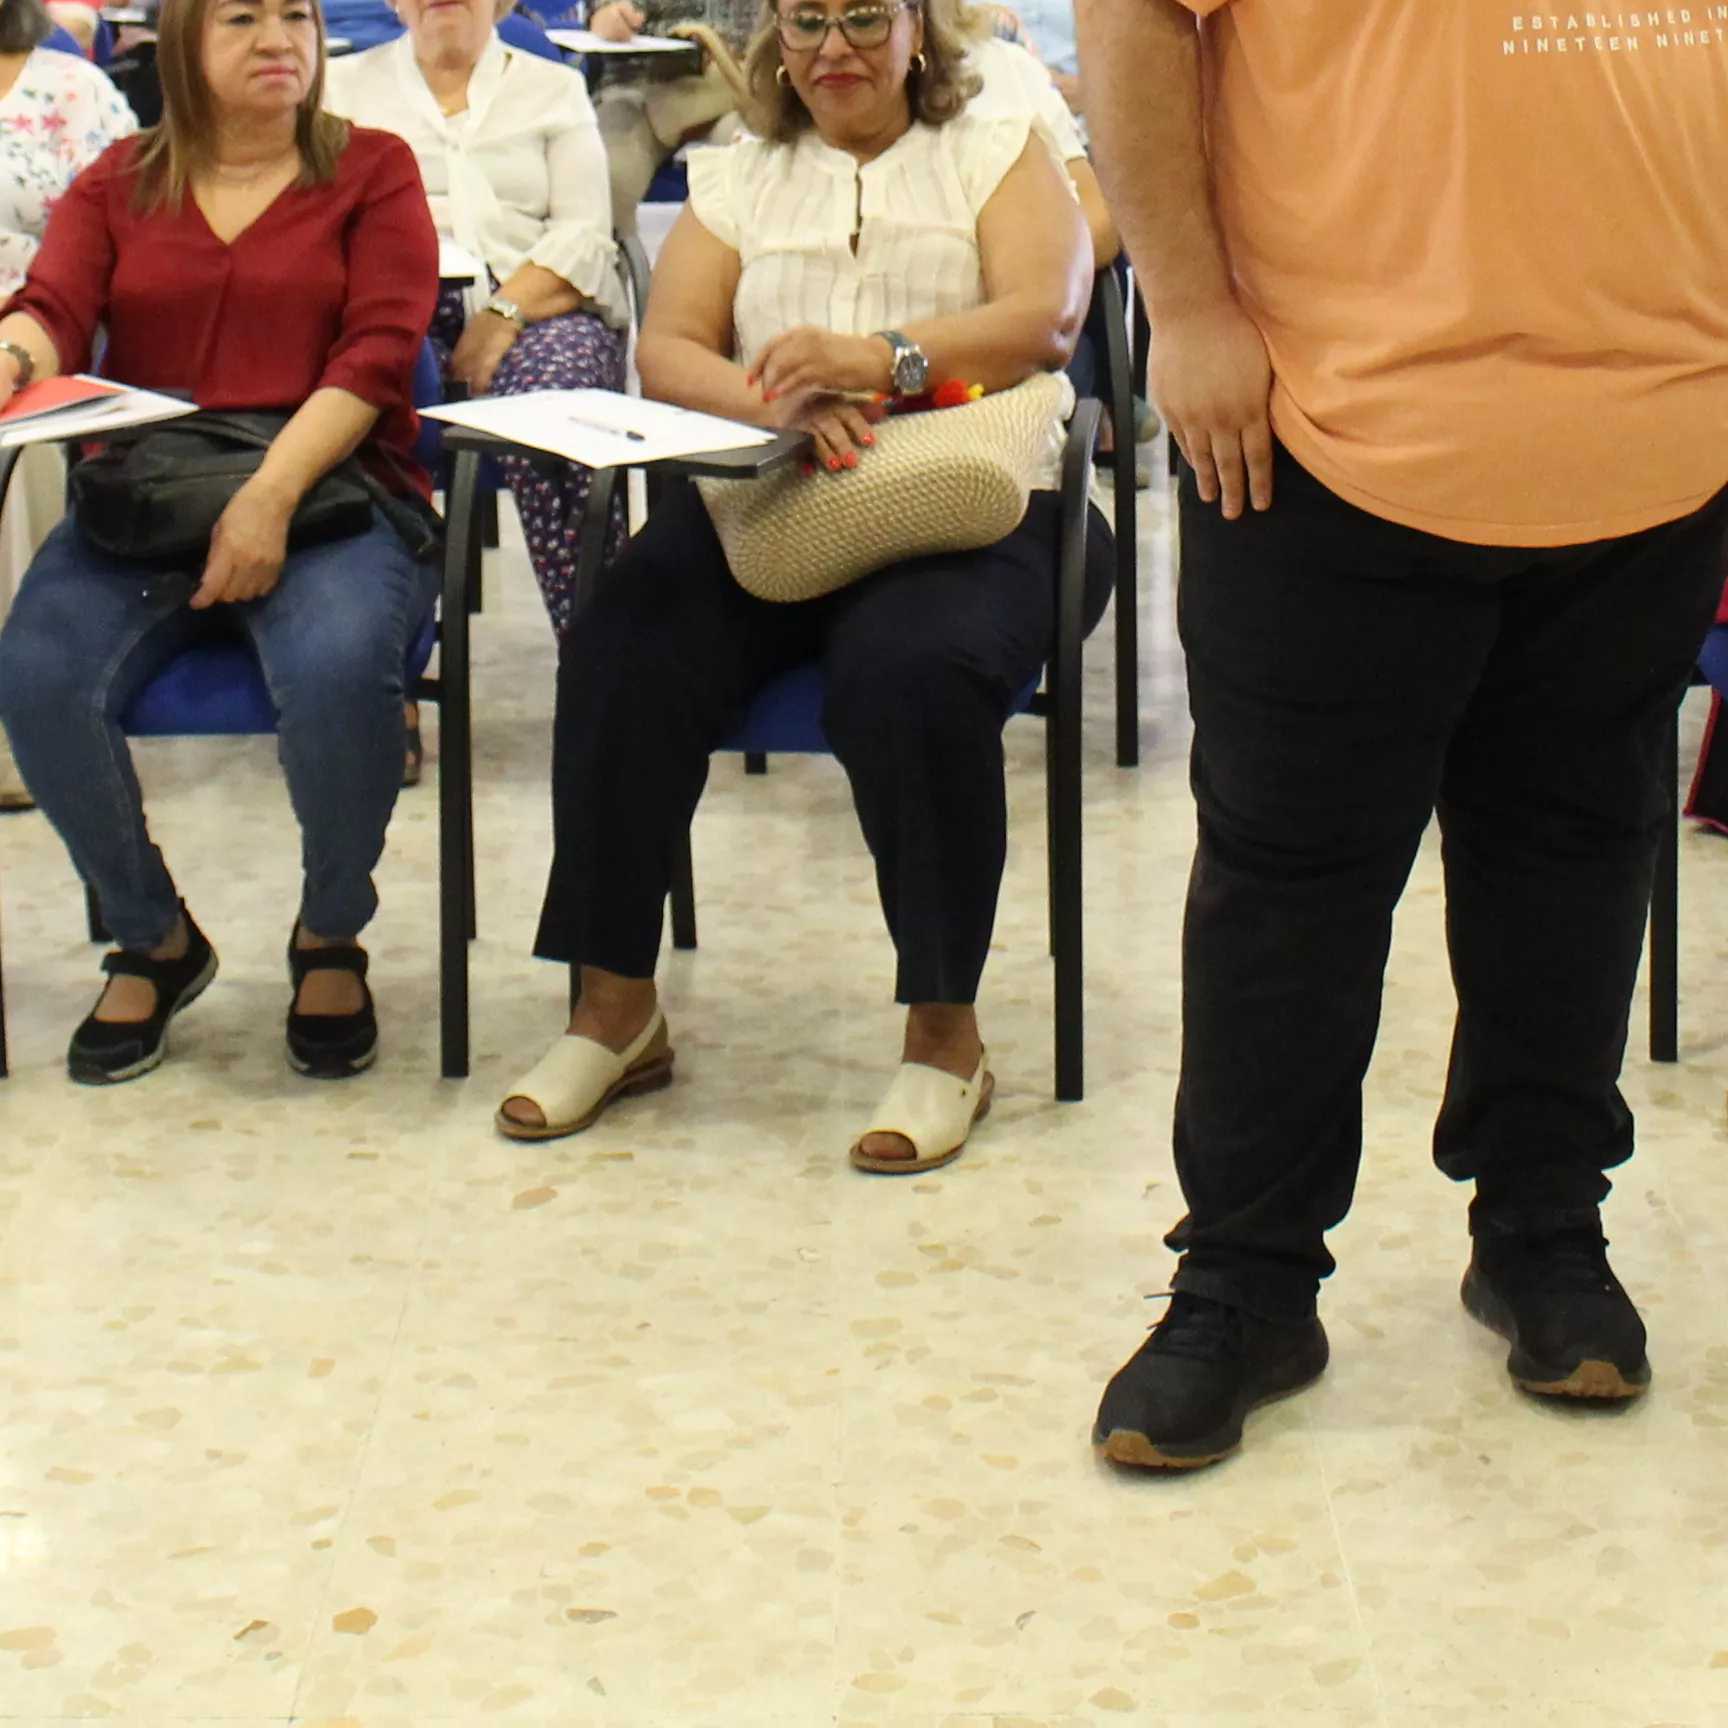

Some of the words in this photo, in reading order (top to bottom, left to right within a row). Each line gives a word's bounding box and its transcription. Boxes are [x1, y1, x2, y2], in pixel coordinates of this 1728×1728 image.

[1512, 9, 1692, 32] ESTABLISHED
[1707, 5, 1728, 21] IN
[1503, 36, 1639, 55] NINETEEN
